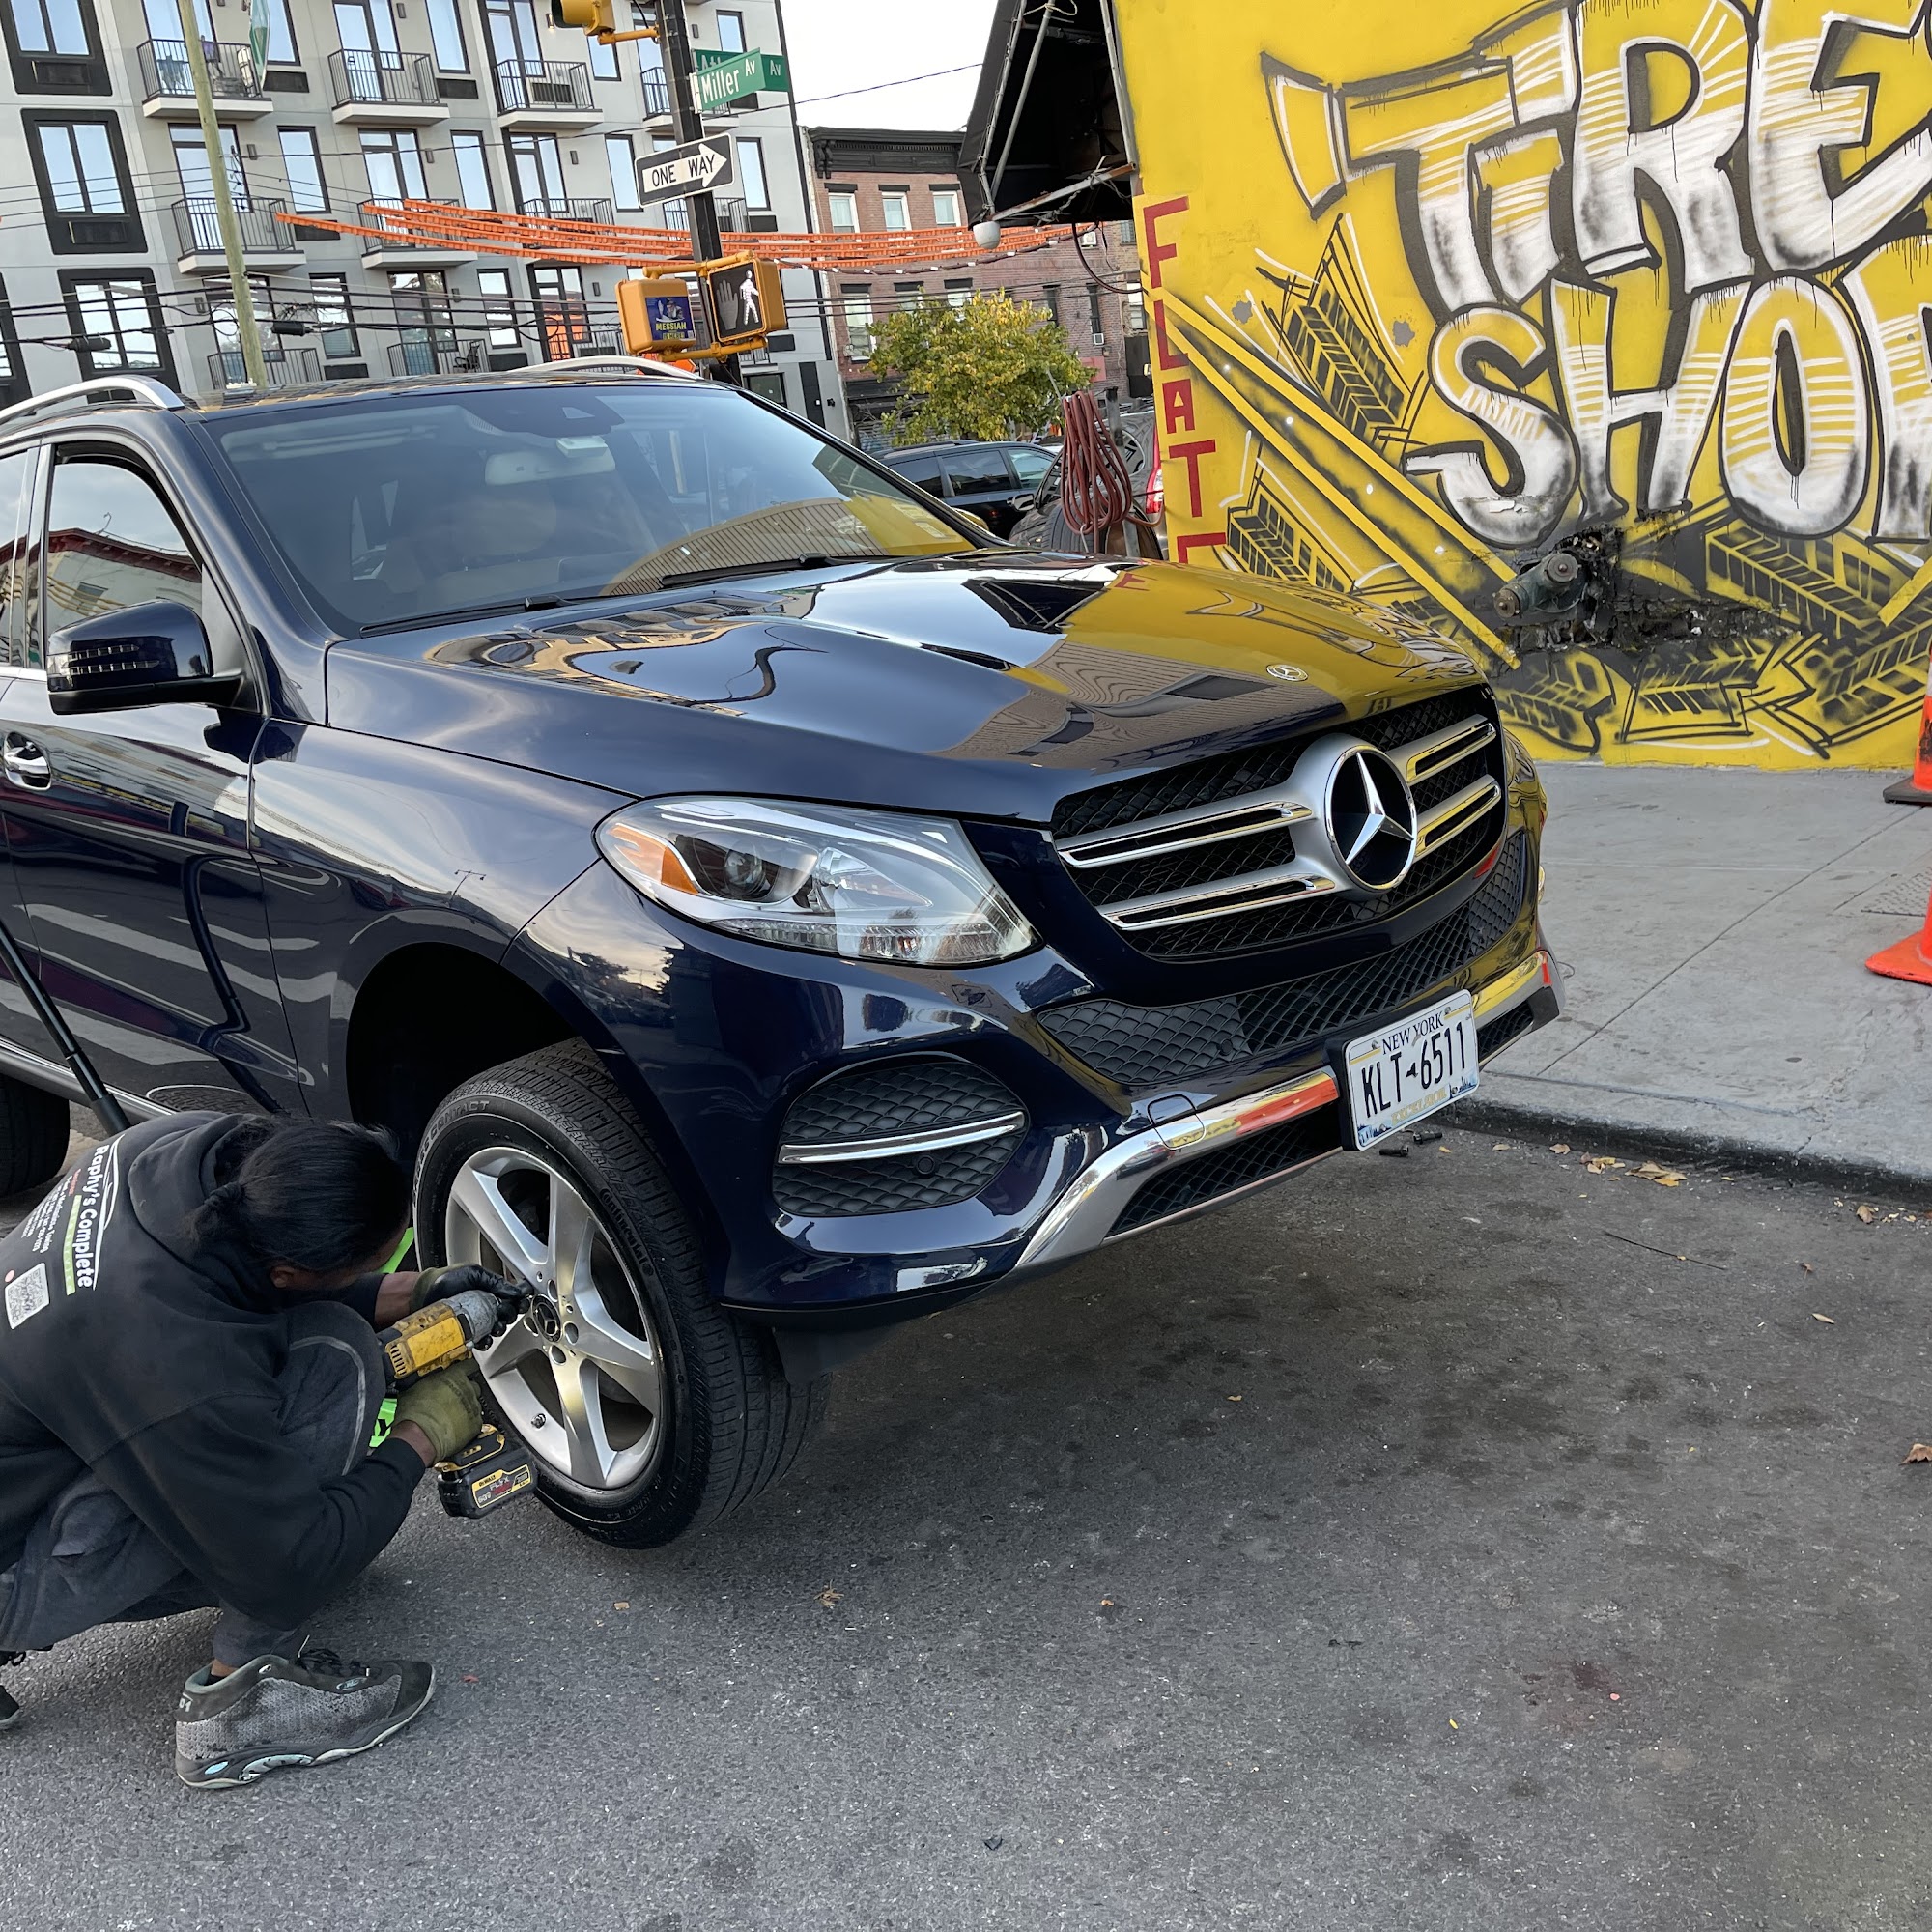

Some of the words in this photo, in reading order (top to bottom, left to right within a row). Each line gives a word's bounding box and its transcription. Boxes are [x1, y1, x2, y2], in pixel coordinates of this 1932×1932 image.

[700, 69, 739, 104] Miller
[745, 58, 755, 77] Av
[770, 59, 781, 76] Av
[651, 166, 677, 187] ONE
[688, 155, 716, 178] WAY
[655, 322, 687, 331] MESSIAH
[1143, 196, 1216, 518] FLAT
[1382, 1029, 1410, 1055] NEW
[1412, 1011, 1444, 1037] YORK
[1361, 1051, 1402, 1119] KLT
[1421, 1021, 1465, 1089] 6511
[83, 1144, 110, 1207] Raphy's
[72, 1208, 98, 1288] Complete
[599, 1188, 648, 1264] Continental
